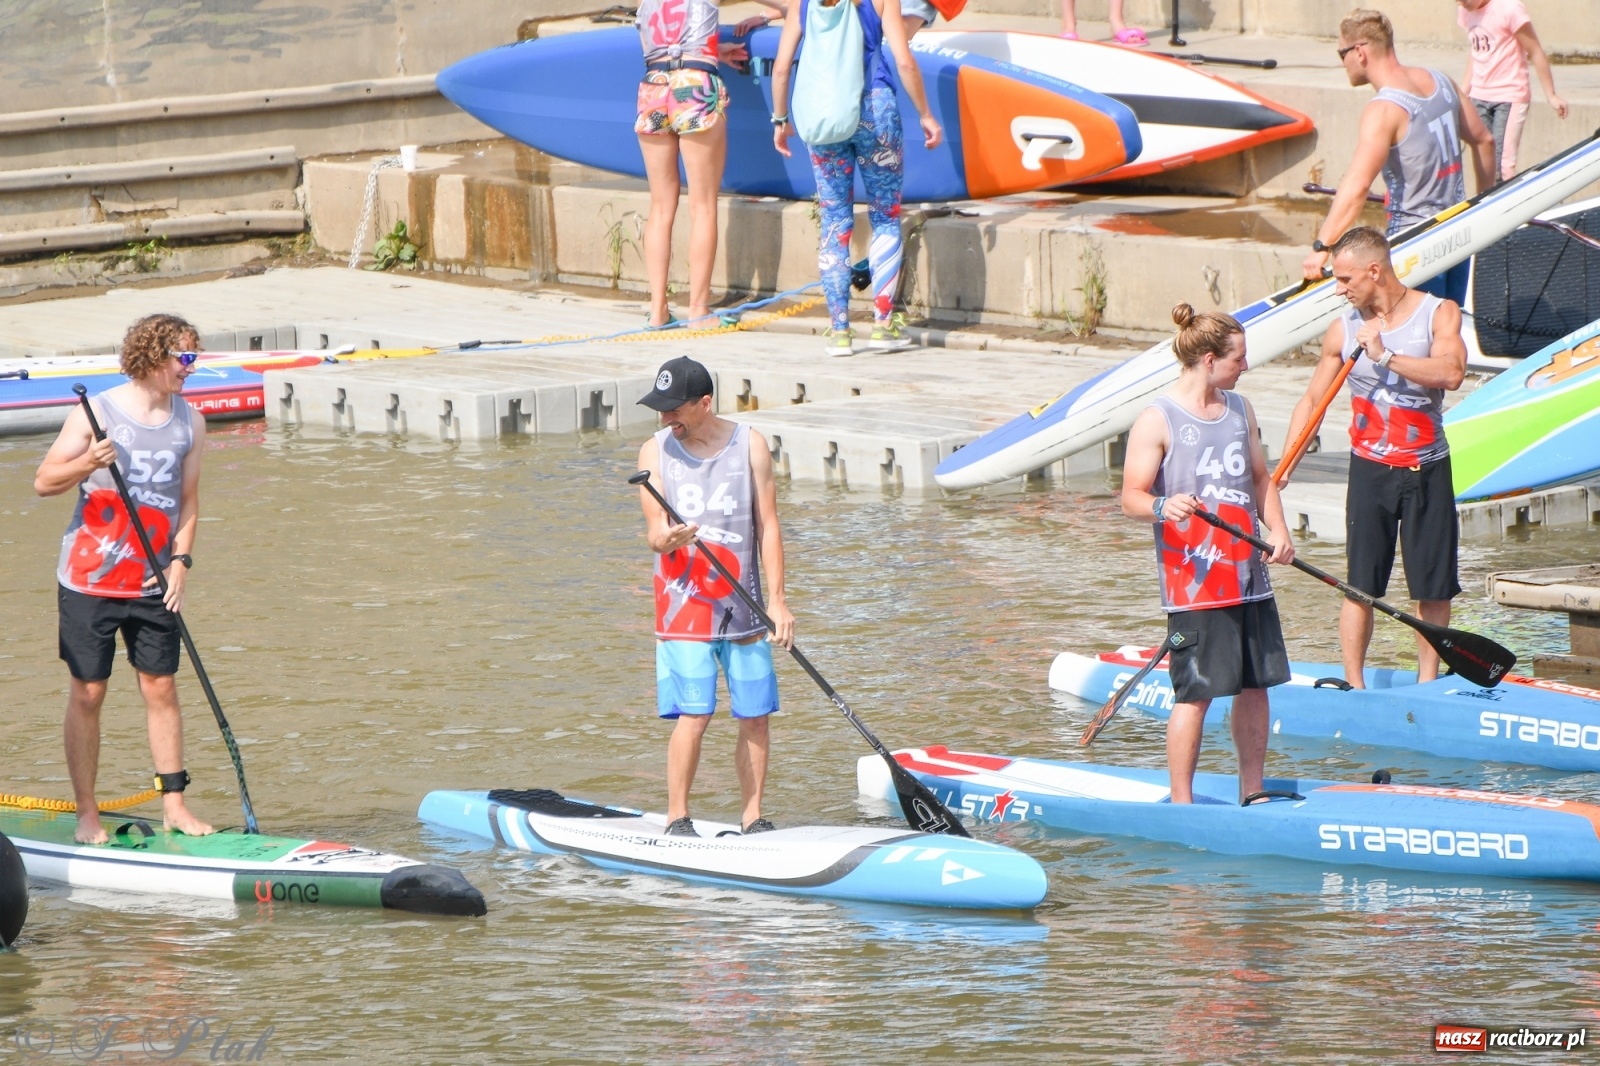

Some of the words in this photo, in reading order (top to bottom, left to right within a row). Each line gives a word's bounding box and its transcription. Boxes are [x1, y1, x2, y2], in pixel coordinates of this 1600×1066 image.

[1428, 110, 1459, 164] 11
[1421, 226, 1471, 267] HAWAII
[1372, 389, 1431, 408] NSP
[127, 450, 176, 483] 52
[1196, 441, 1246, 479] 46
[127, 486, 176, 509] NSP
[676, 482, 737, 518] 84
[1201, 484, 1250, 505] NSP
[1319, 823, 1528, 860] STARBOARD
